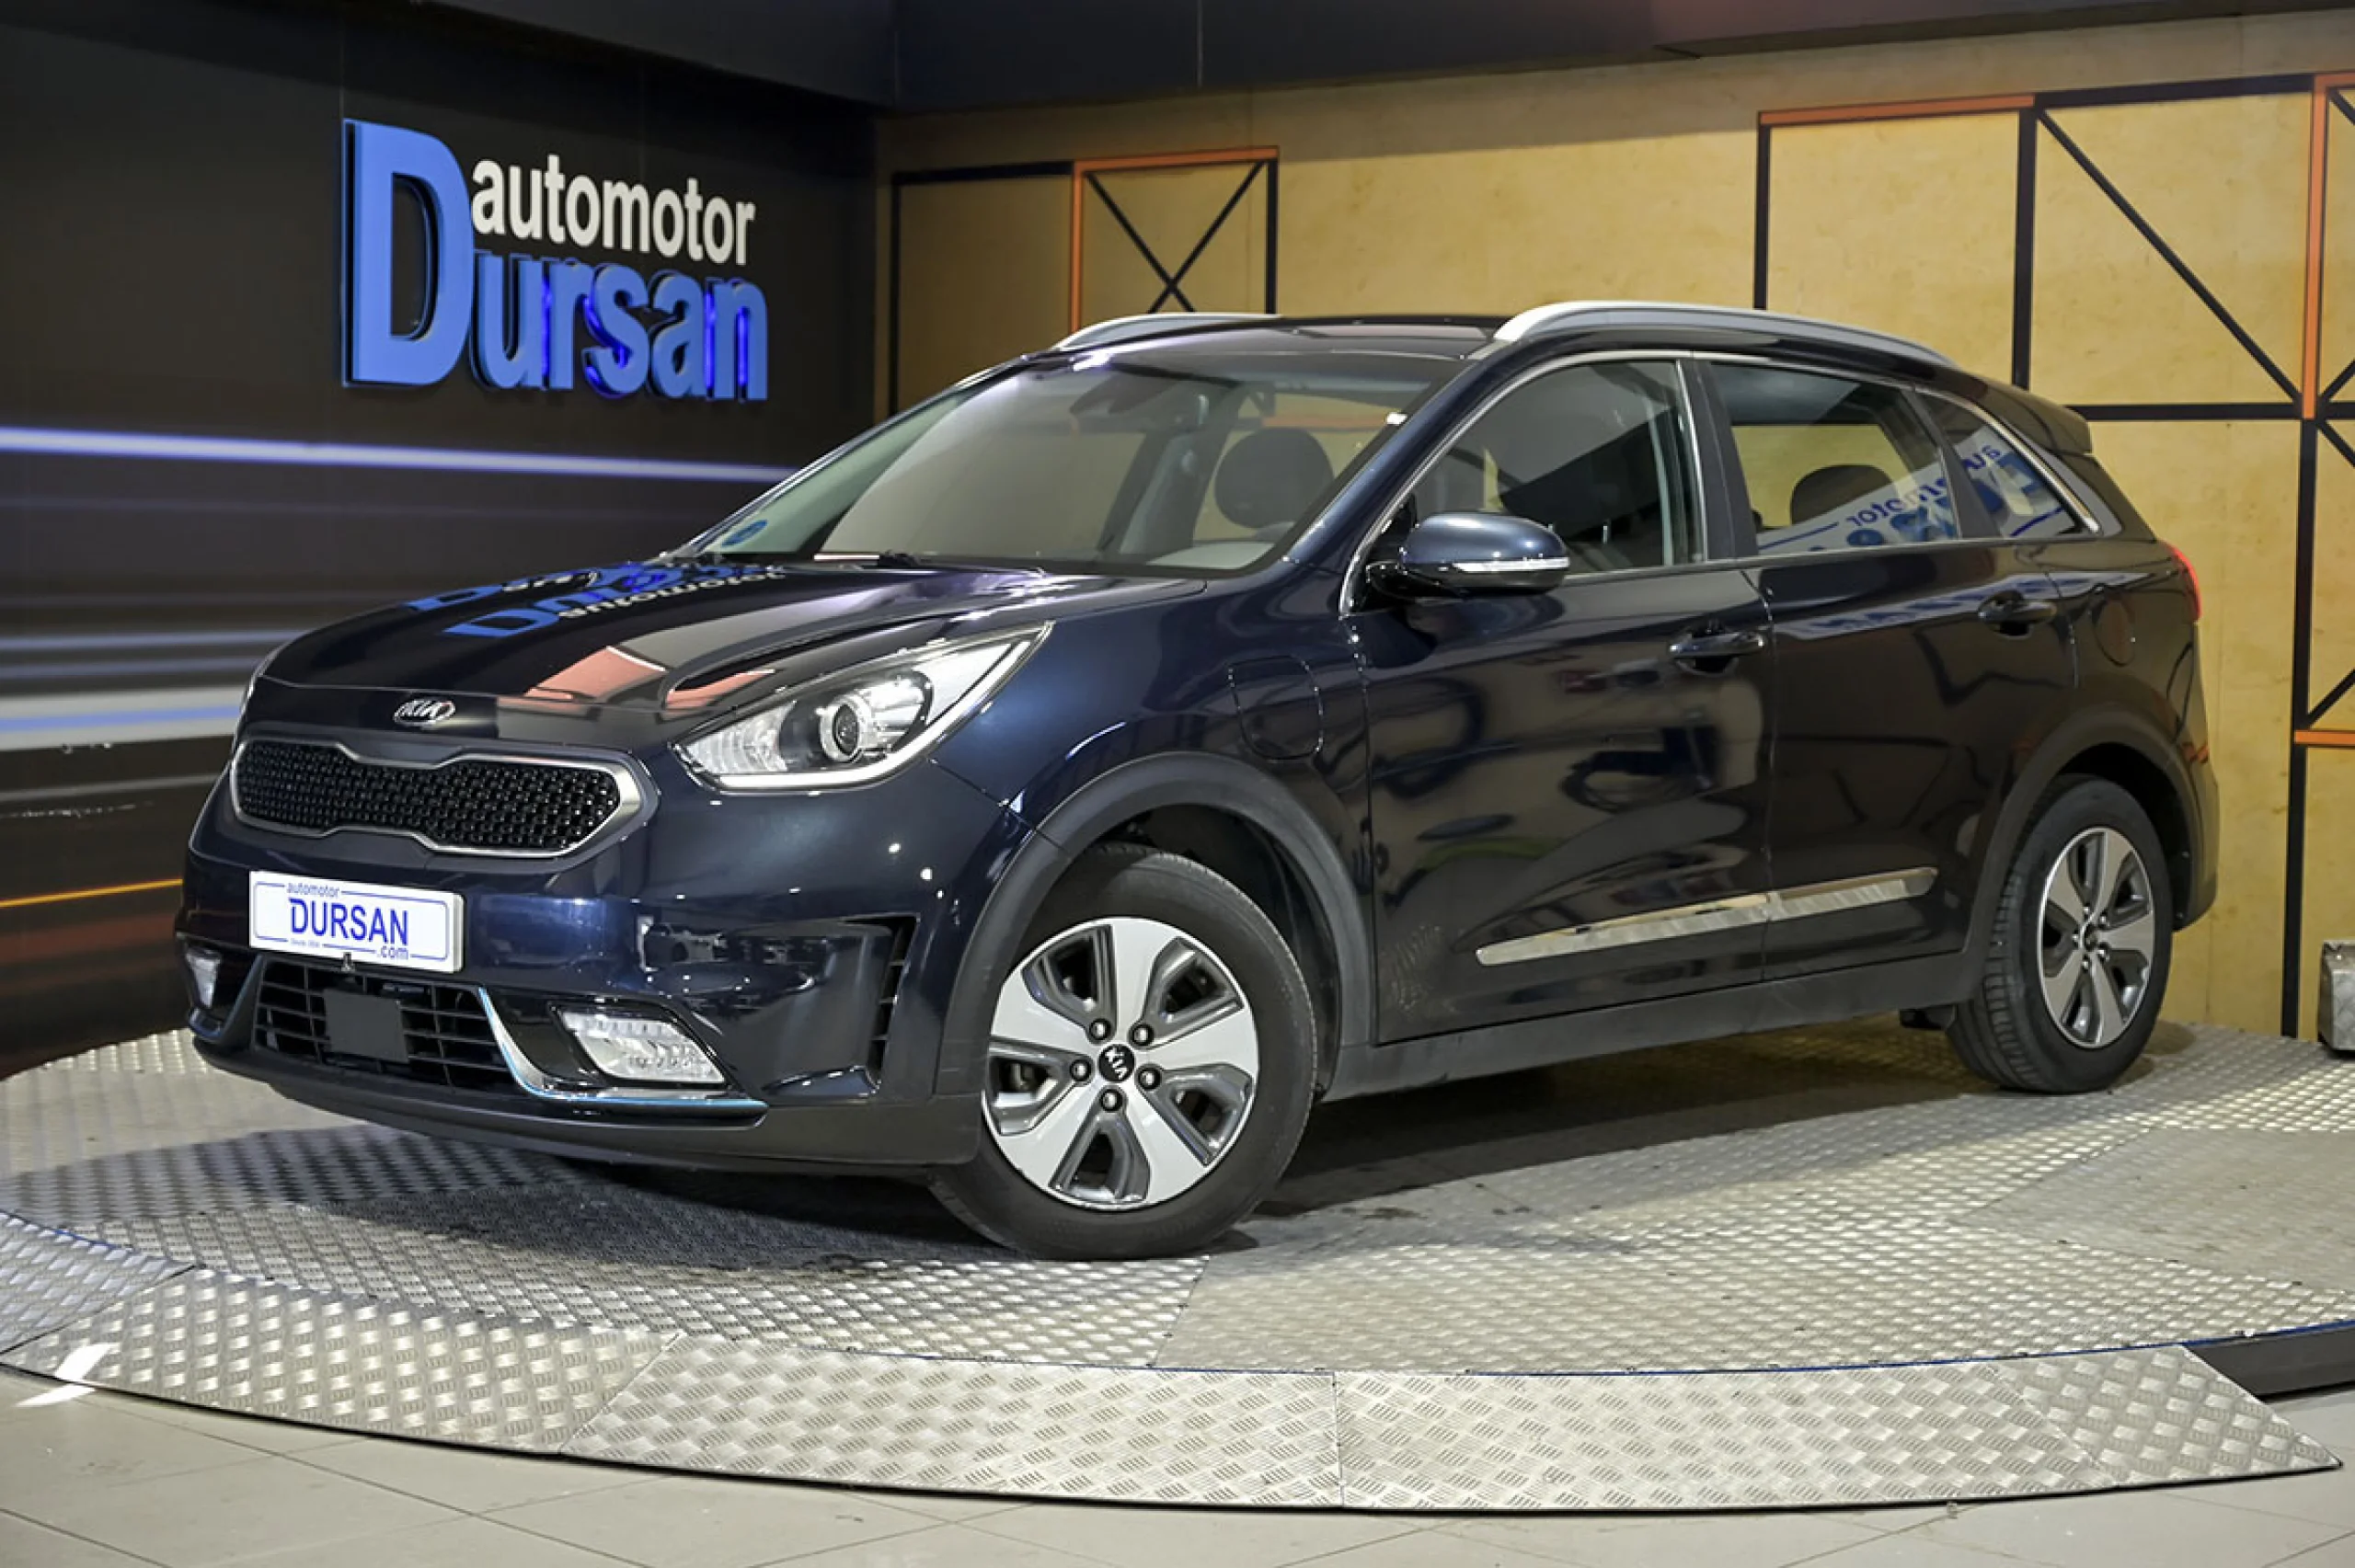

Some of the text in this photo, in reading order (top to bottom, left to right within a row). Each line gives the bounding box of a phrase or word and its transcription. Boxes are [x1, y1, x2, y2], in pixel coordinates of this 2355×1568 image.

[471, 154, 756, 266] automotor
[342, 119, 769, 403] Dursan
[287, 882, 339, 898] automotor
[288, 898, 408, 946] DURSAN
